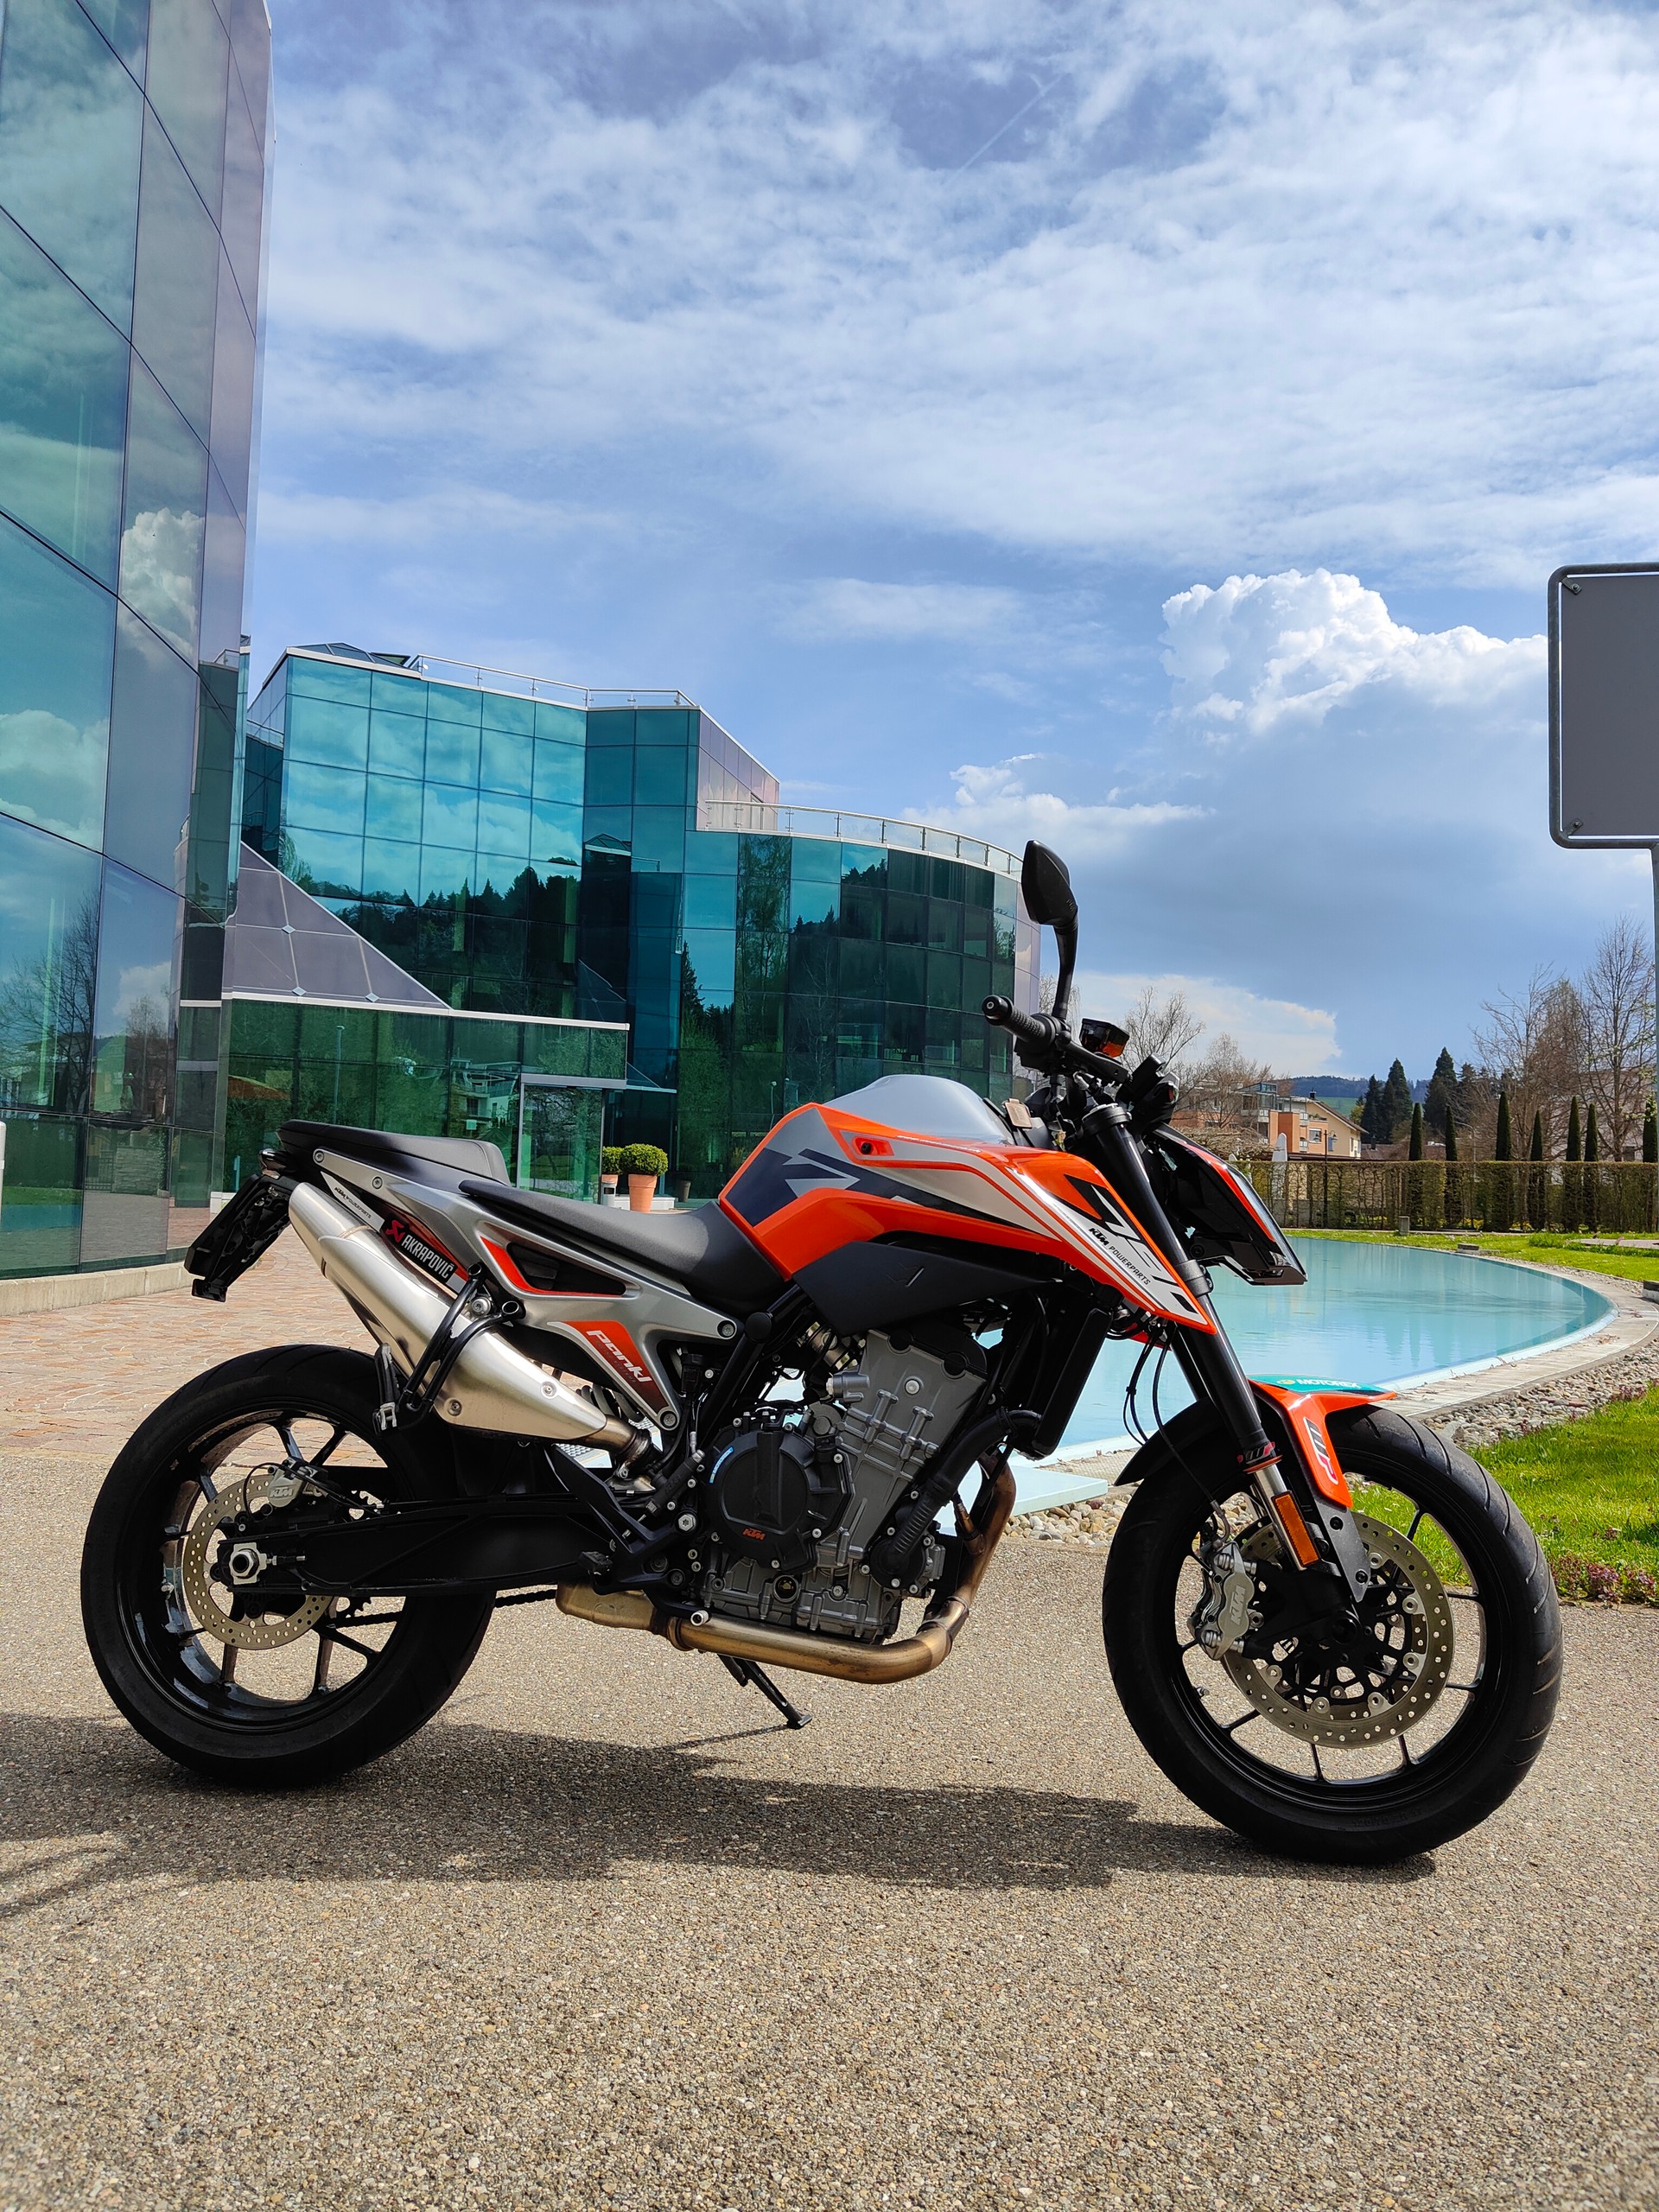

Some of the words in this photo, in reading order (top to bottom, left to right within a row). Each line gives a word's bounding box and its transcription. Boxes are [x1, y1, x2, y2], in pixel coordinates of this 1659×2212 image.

[1089, 1227, 1109, 1245] KTM
[1109, 1245, 1151, 1285] POWERPARTS
[1296, 1378, 1362, 1389] MOTOREX
[269, 1486, 293, 1497] KTM
[742, 1528, 766, 1541] KTM
[1230, 1585, 1246, 1625] KTM
